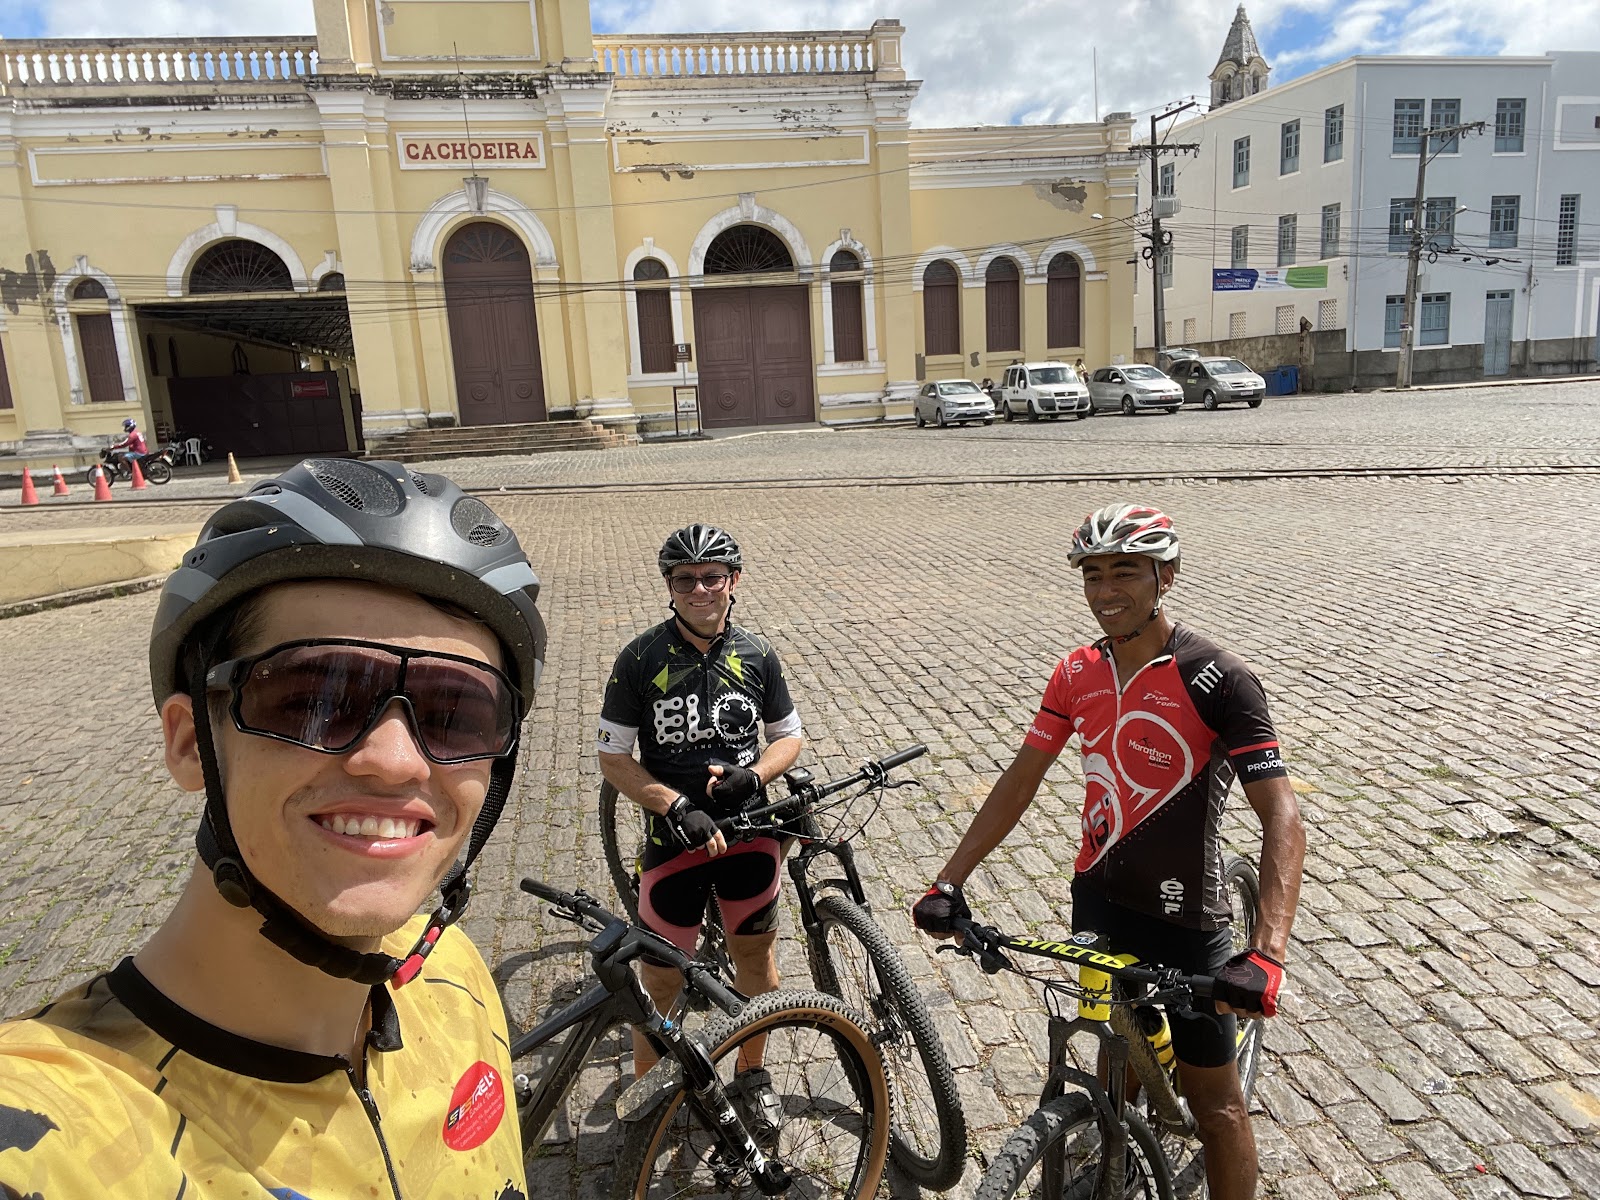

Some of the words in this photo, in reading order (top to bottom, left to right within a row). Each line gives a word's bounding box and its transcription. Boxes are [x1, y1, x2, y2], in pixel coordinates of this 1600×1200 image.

[406, 142, 537, 160] CACHOEIRA
[1190, 660, 1223, 694] TNT
[1082, 688, 1115, 701] CRISTAL
[1128, 739, 1172, 761] Marathon
[775, 1012, 837, 1025] MAXXIS
